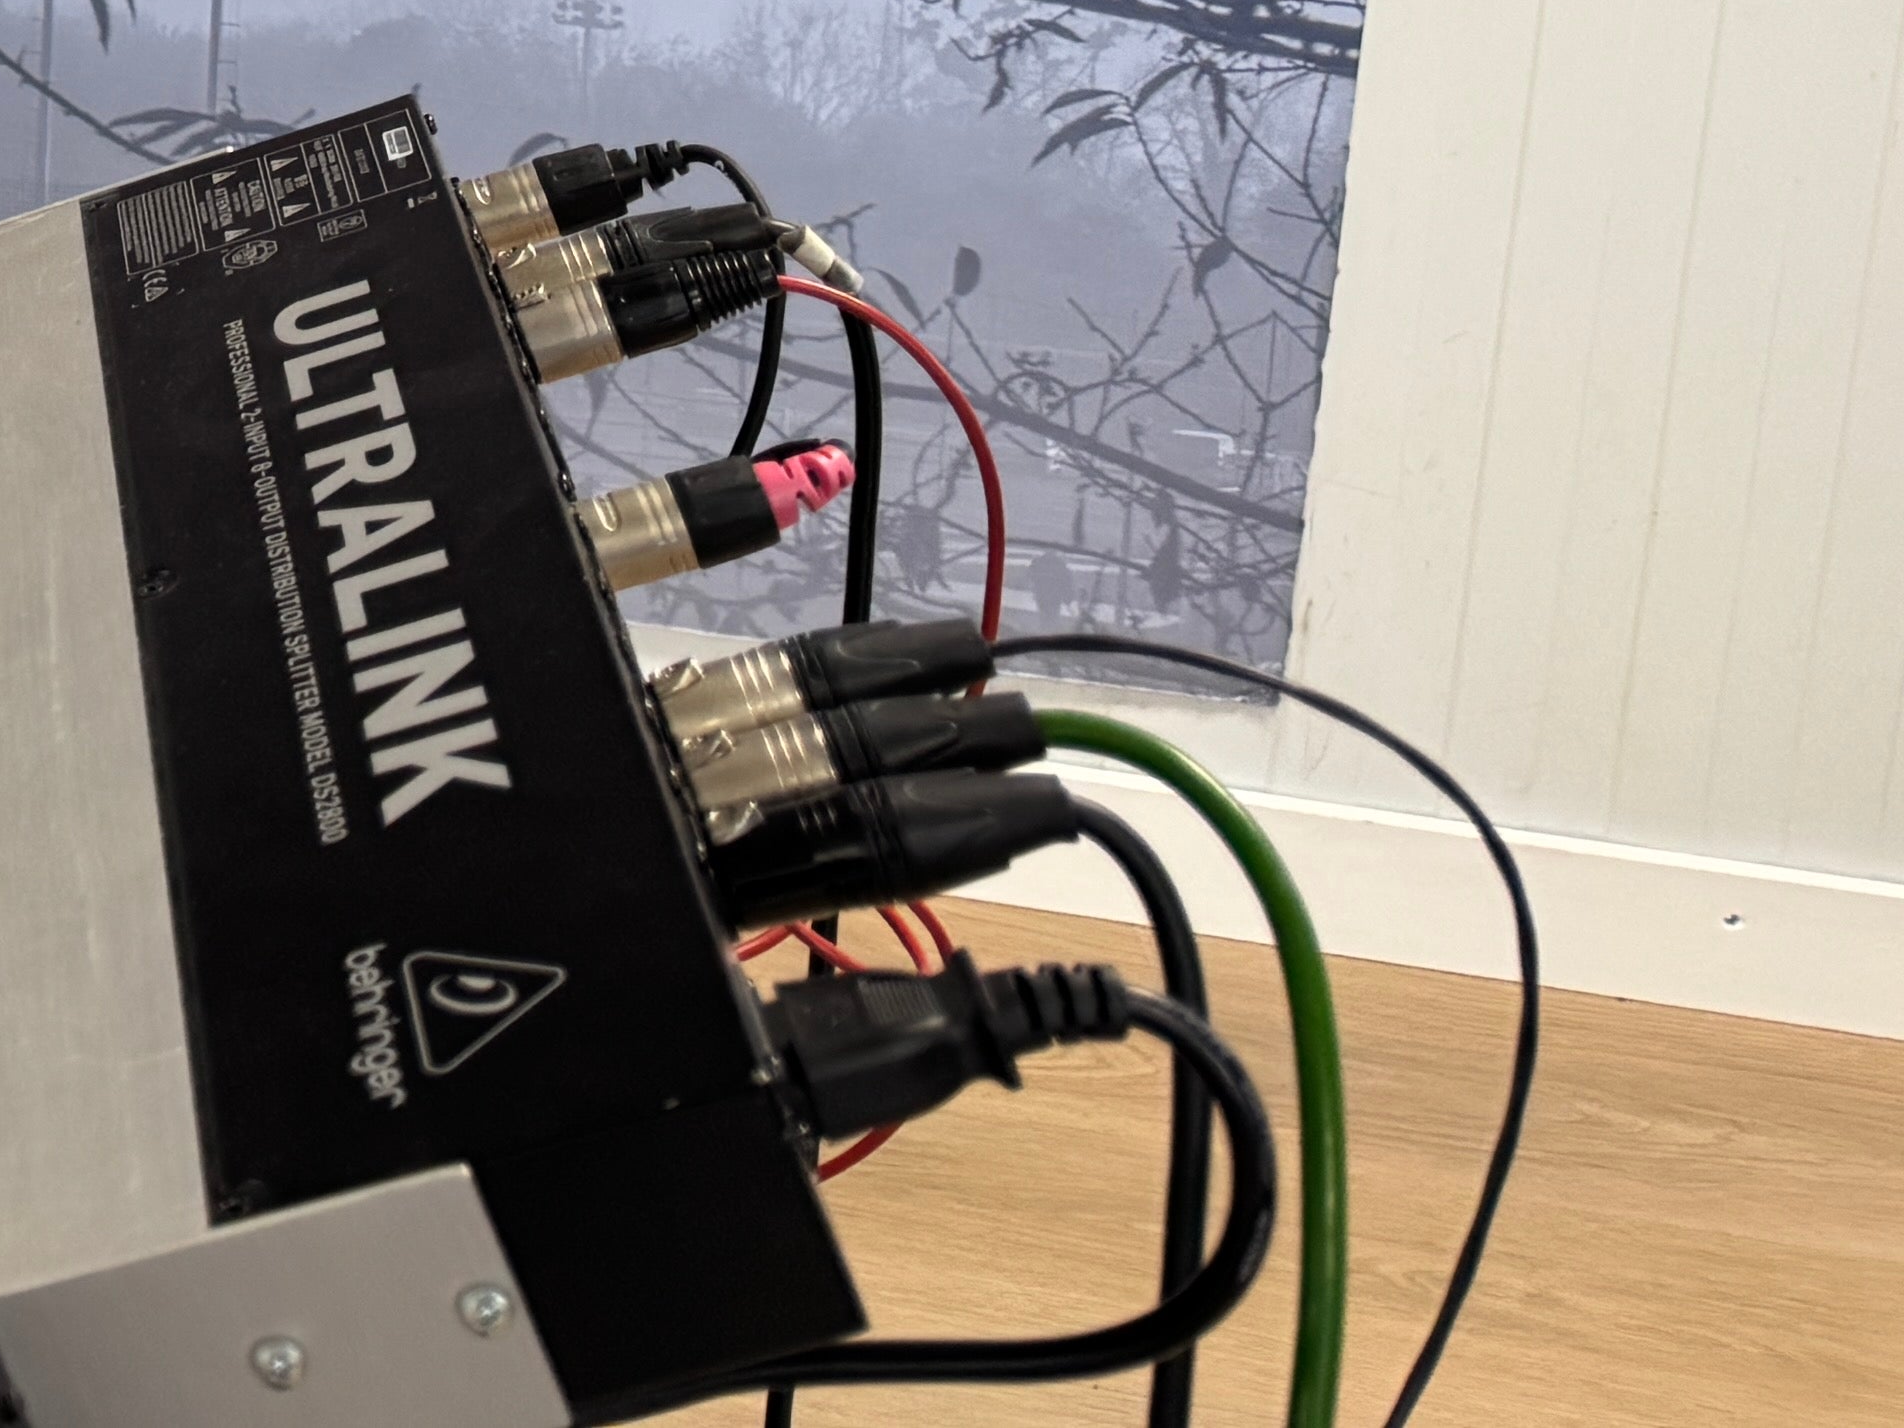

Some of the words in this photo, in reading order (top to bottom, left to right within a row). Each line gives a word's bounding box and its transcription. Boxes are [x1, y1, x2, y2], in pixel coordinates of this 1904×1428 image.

[223, 318, 259, 410] PROFESSIONAL
[240, 408, 270, 460] 2-INPUT
[250, 461, 286, 530] 8-OUTPUT
[264, 532, 305, 634] DISTRIBUTION
[273, 279, 512, 828] ULTRALINK
[284, 633, 322, 713] SPLITTER
[299, 710, 334, 774] MODEL
[310, 772, 350, 846] DS2800
[344, 942, 408, 1110] behringer
